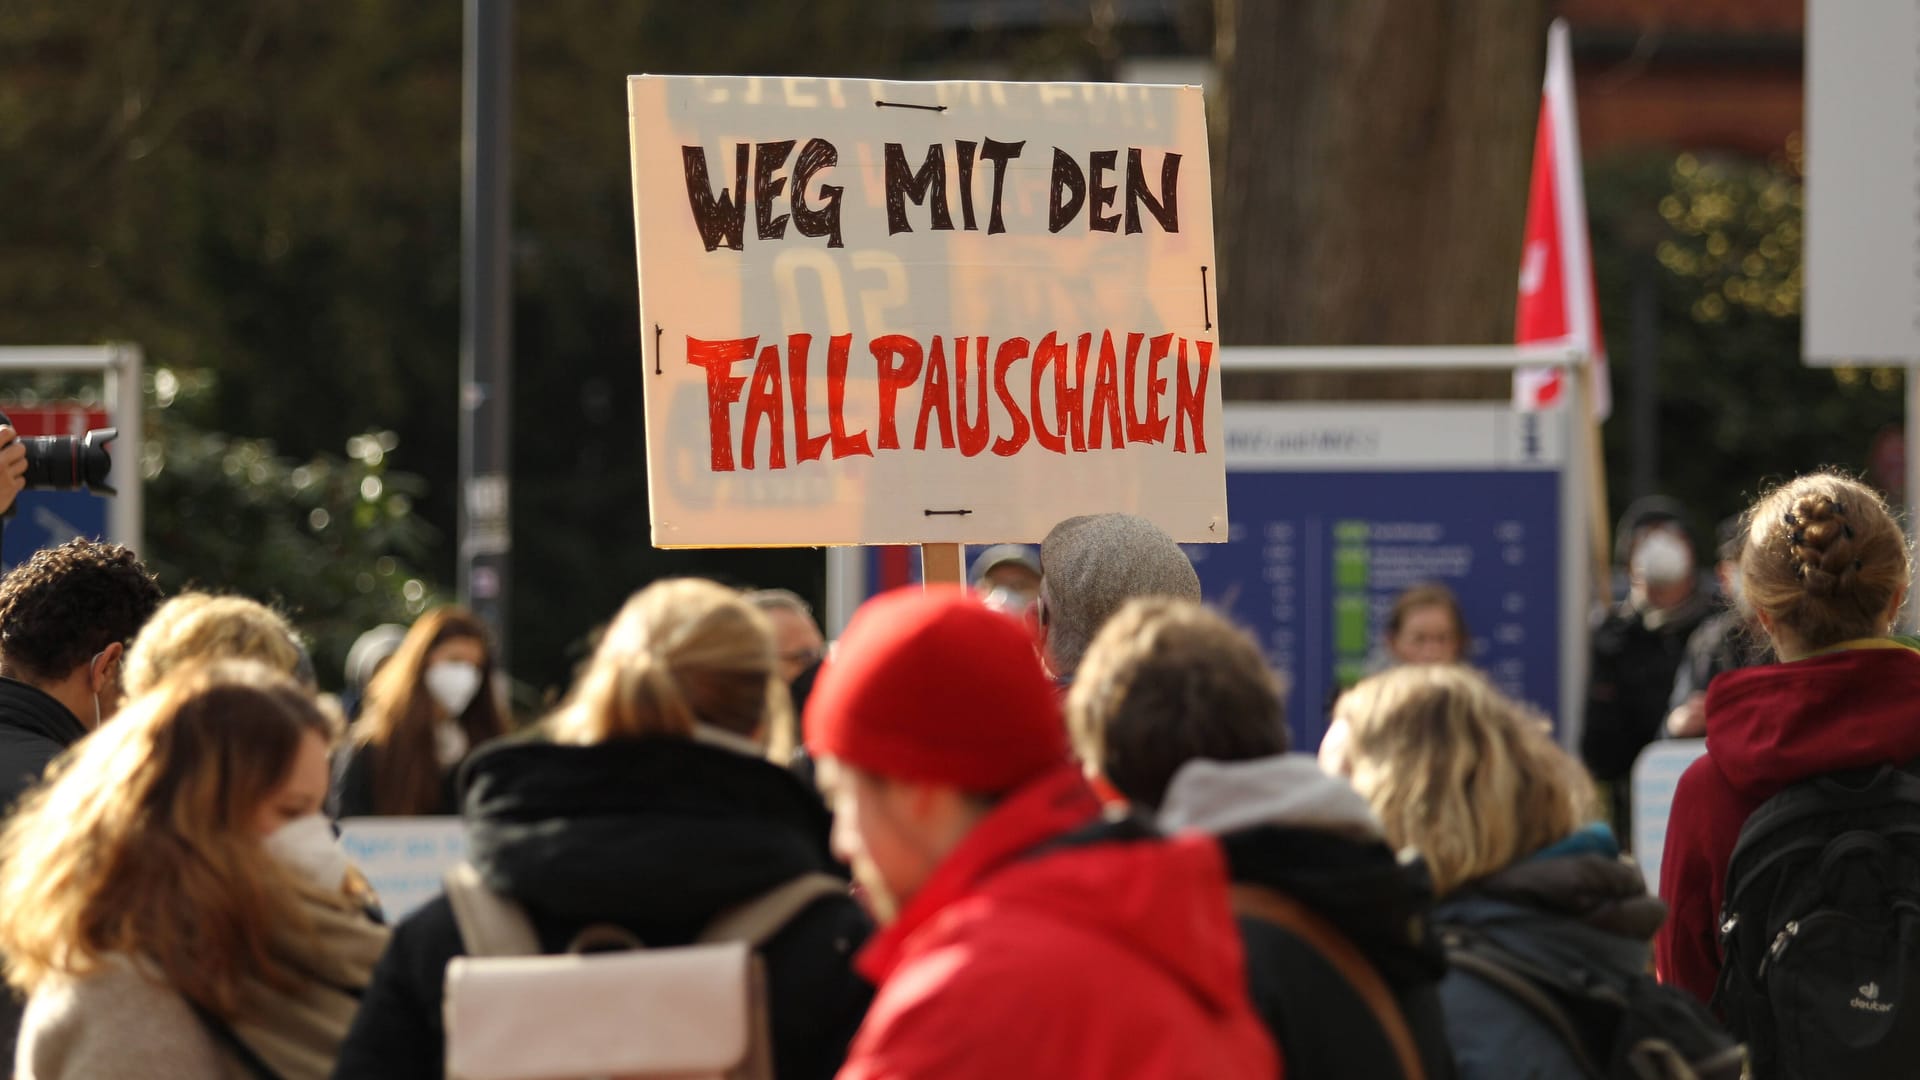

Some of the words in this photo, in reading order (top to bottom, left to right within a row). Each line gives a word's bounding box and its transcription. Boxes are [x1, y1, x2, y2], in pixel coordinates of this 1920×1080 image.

[682, 138, 844, 251] WEG
[885, 137, 1026, 236] MIT
[1049, 147, 1182, 235] DEN
[686, 330, 1213, 471] FALLPAUSCHALEN
[1850, 997, 1894, 1012] deuter
